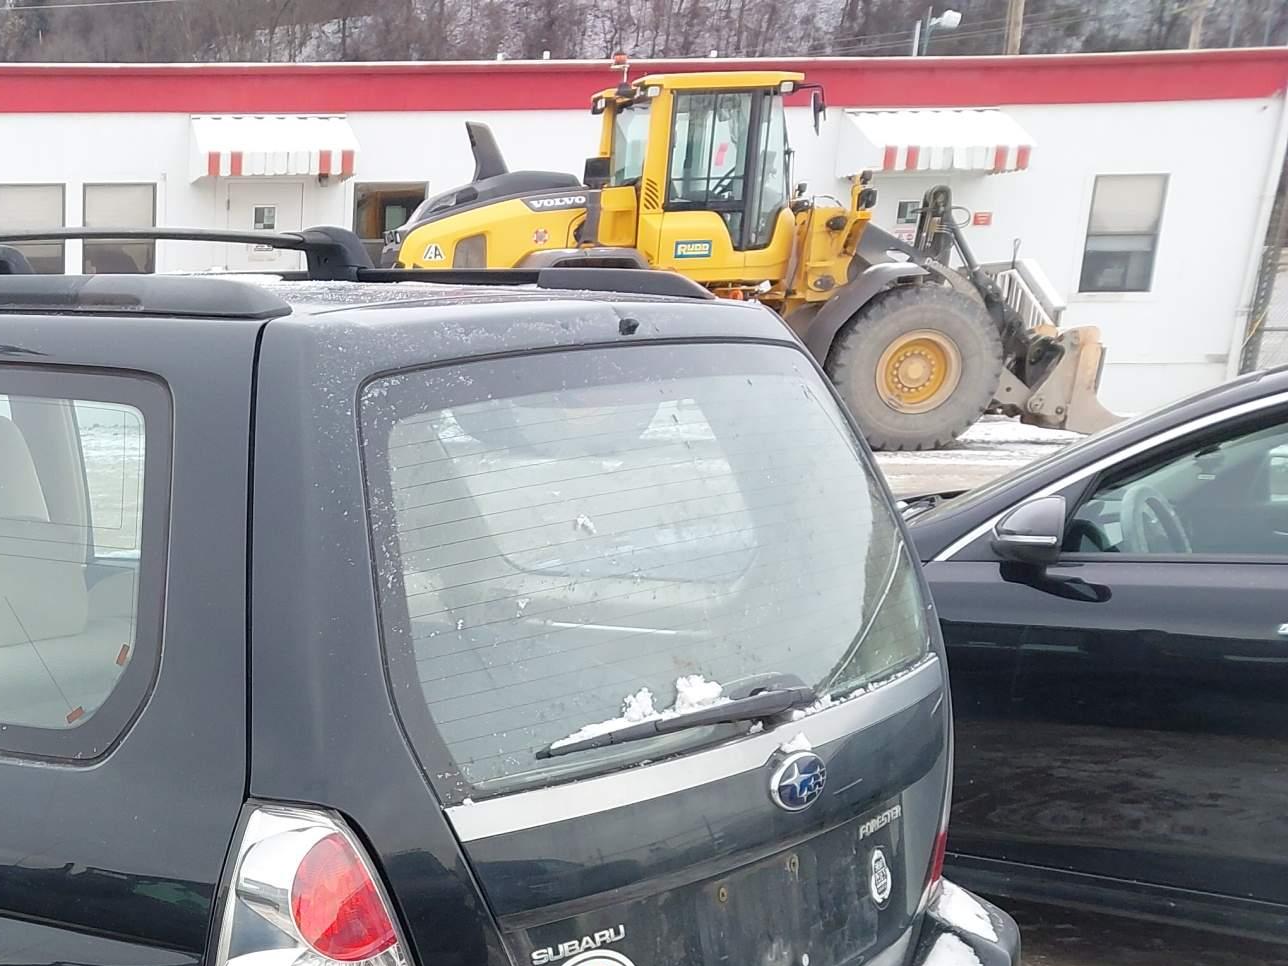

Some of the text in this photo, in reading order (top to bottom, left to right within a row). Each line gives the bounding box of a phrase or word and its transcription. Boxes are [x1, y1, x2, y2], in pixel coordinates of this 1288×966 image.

[529, 196, 586, 208] VOLVO
[858, 804, 902, 841] FORESTER
[531, 924, 626, 966] SUBARU
